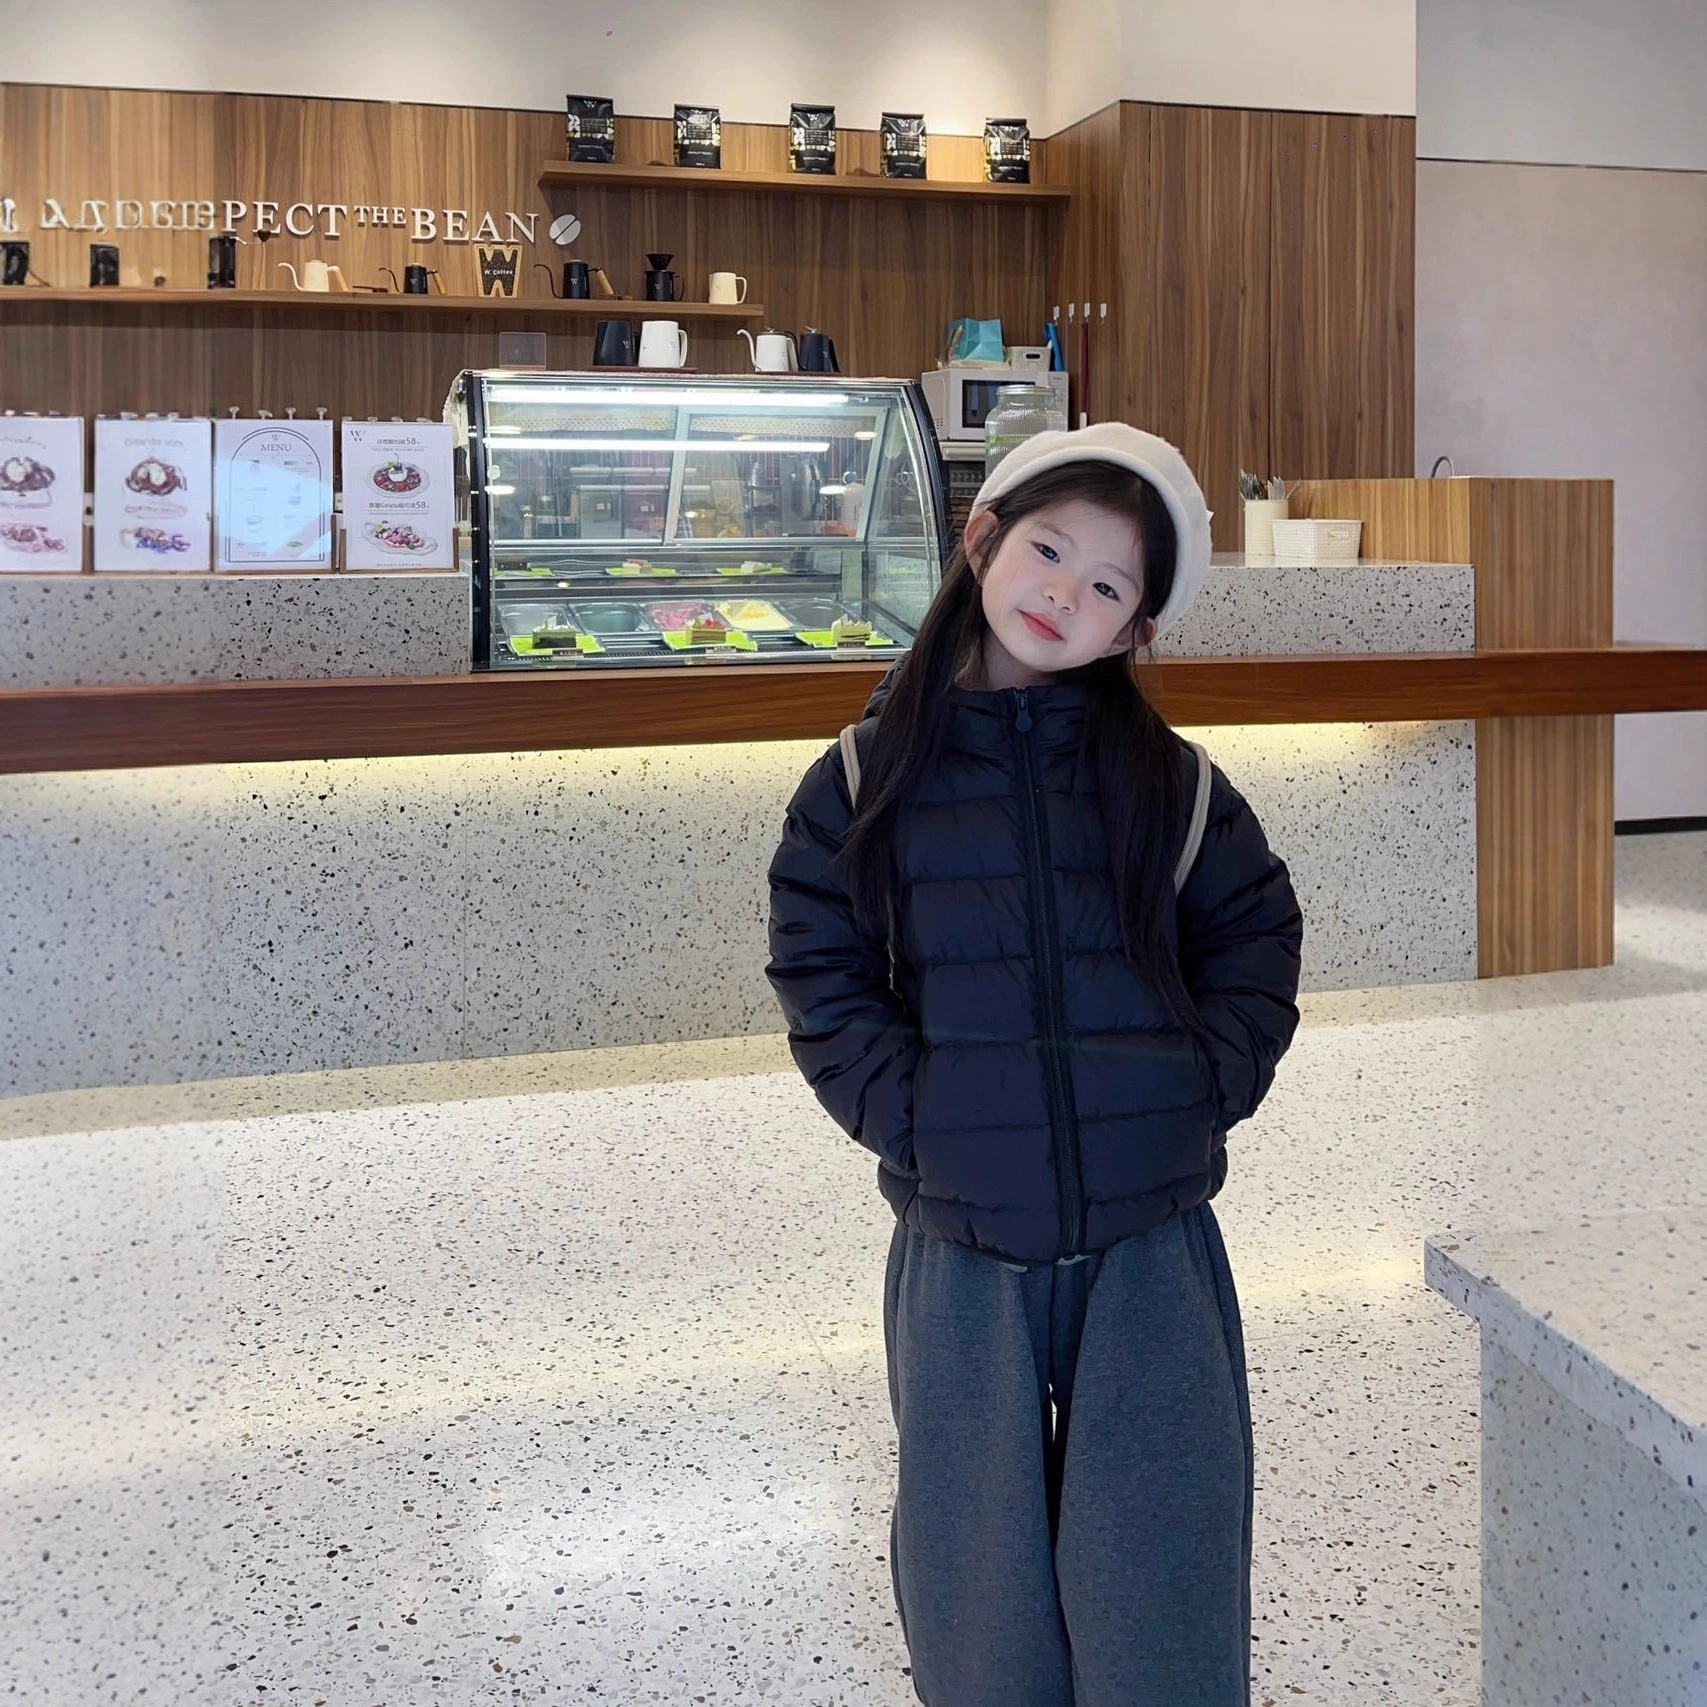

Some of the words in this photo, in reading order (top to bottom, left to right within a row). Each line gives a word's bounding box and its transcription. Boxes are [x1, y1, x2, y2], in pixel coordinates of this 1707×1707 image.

[354, 206, 407, 224] THE
[411, 208, 540, 243] BEAN
[261, 443, 292, 452] MENU
